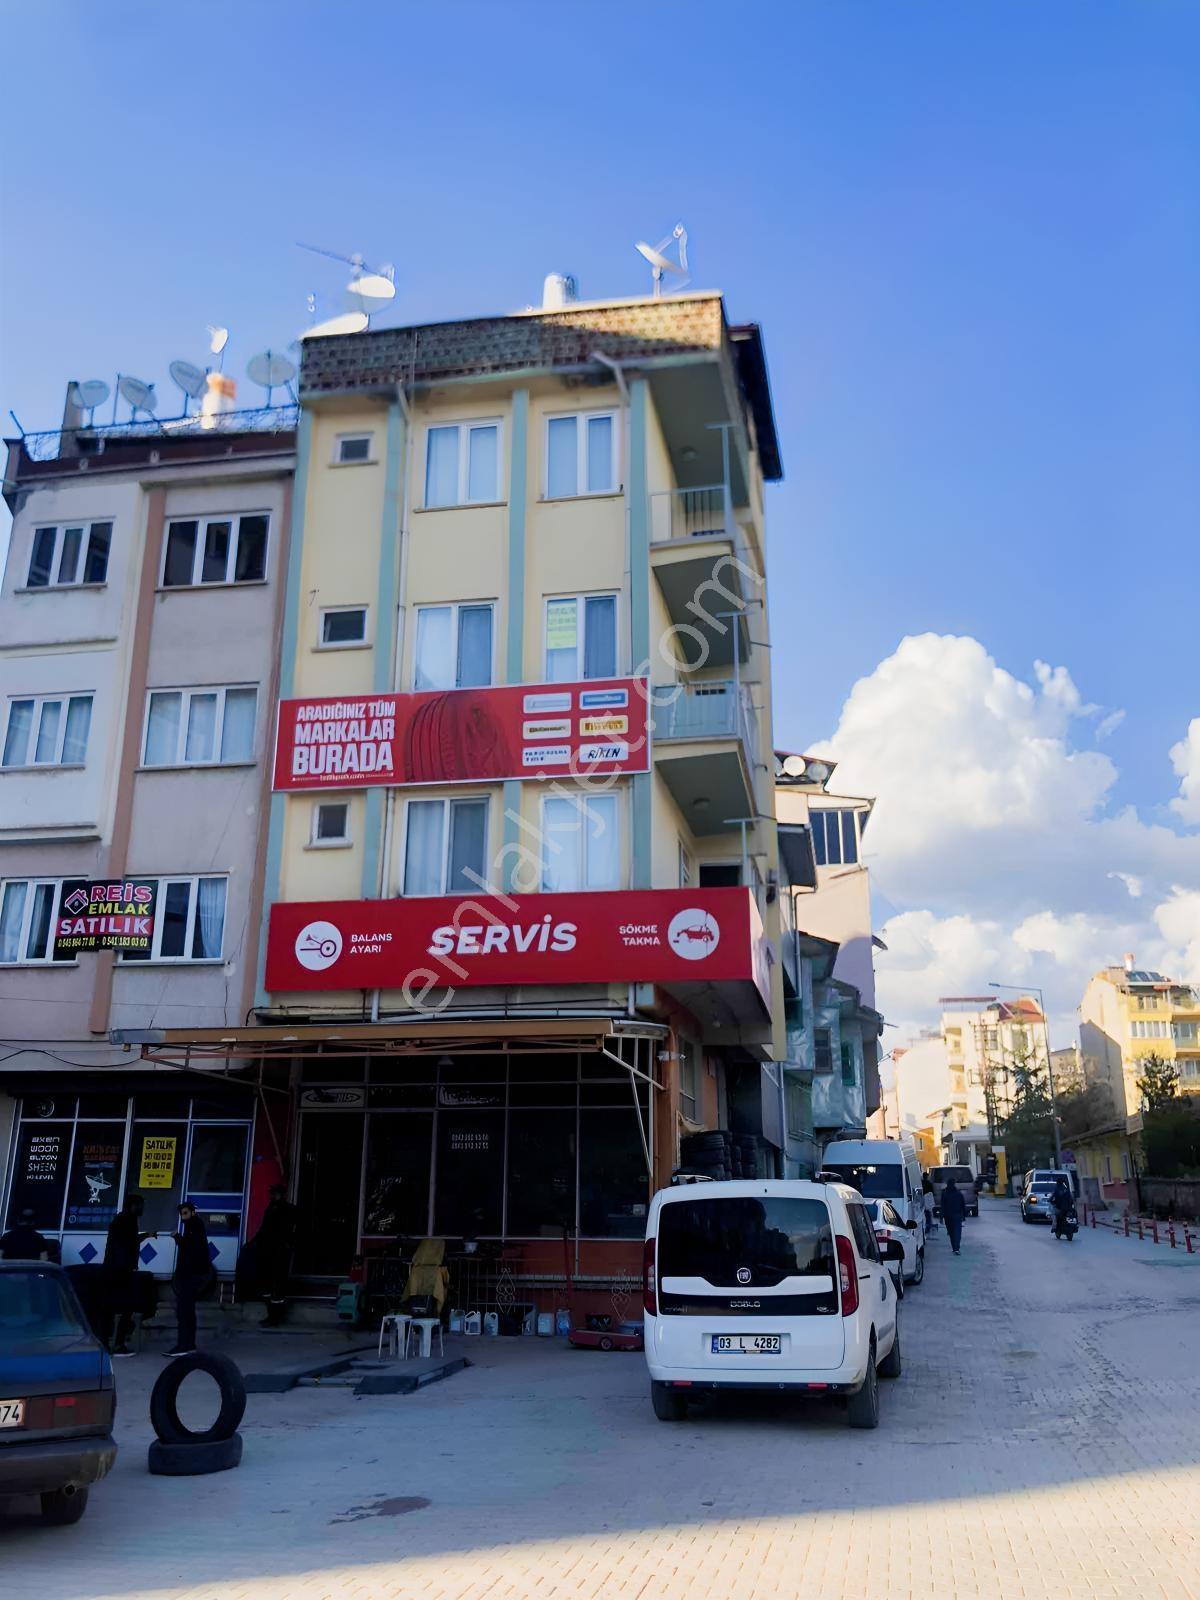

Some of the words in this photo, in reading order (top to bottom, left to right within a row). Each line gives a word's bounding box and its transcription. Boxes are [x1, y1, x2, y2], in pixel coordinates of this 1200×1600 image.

[296, 702, 367, 721] ARADIĞINIZ
[368, 699, 396, 718] TÜM
[294, 718, 395, 744] MARKALAR
[292, 741, 394, 775] BURADA
[89, 903, 149, 914] EMLAK
[60, 917, 151, 935] SATILIK
[619, 924, 658, 935] SÖKME
[351, 933, 393, 943] BALANS
[428, 914, 578, 956] SERVİS
[623, 937, 661, 946] TAKMA
[350, 945, 381, 954] AYARI
[719, 1337, 731, 1349] 03
[740, 1337, 746, 1349] L
[754, 1337, 778, 1349] 4282
[0, 1404, 19, 1423] 74
